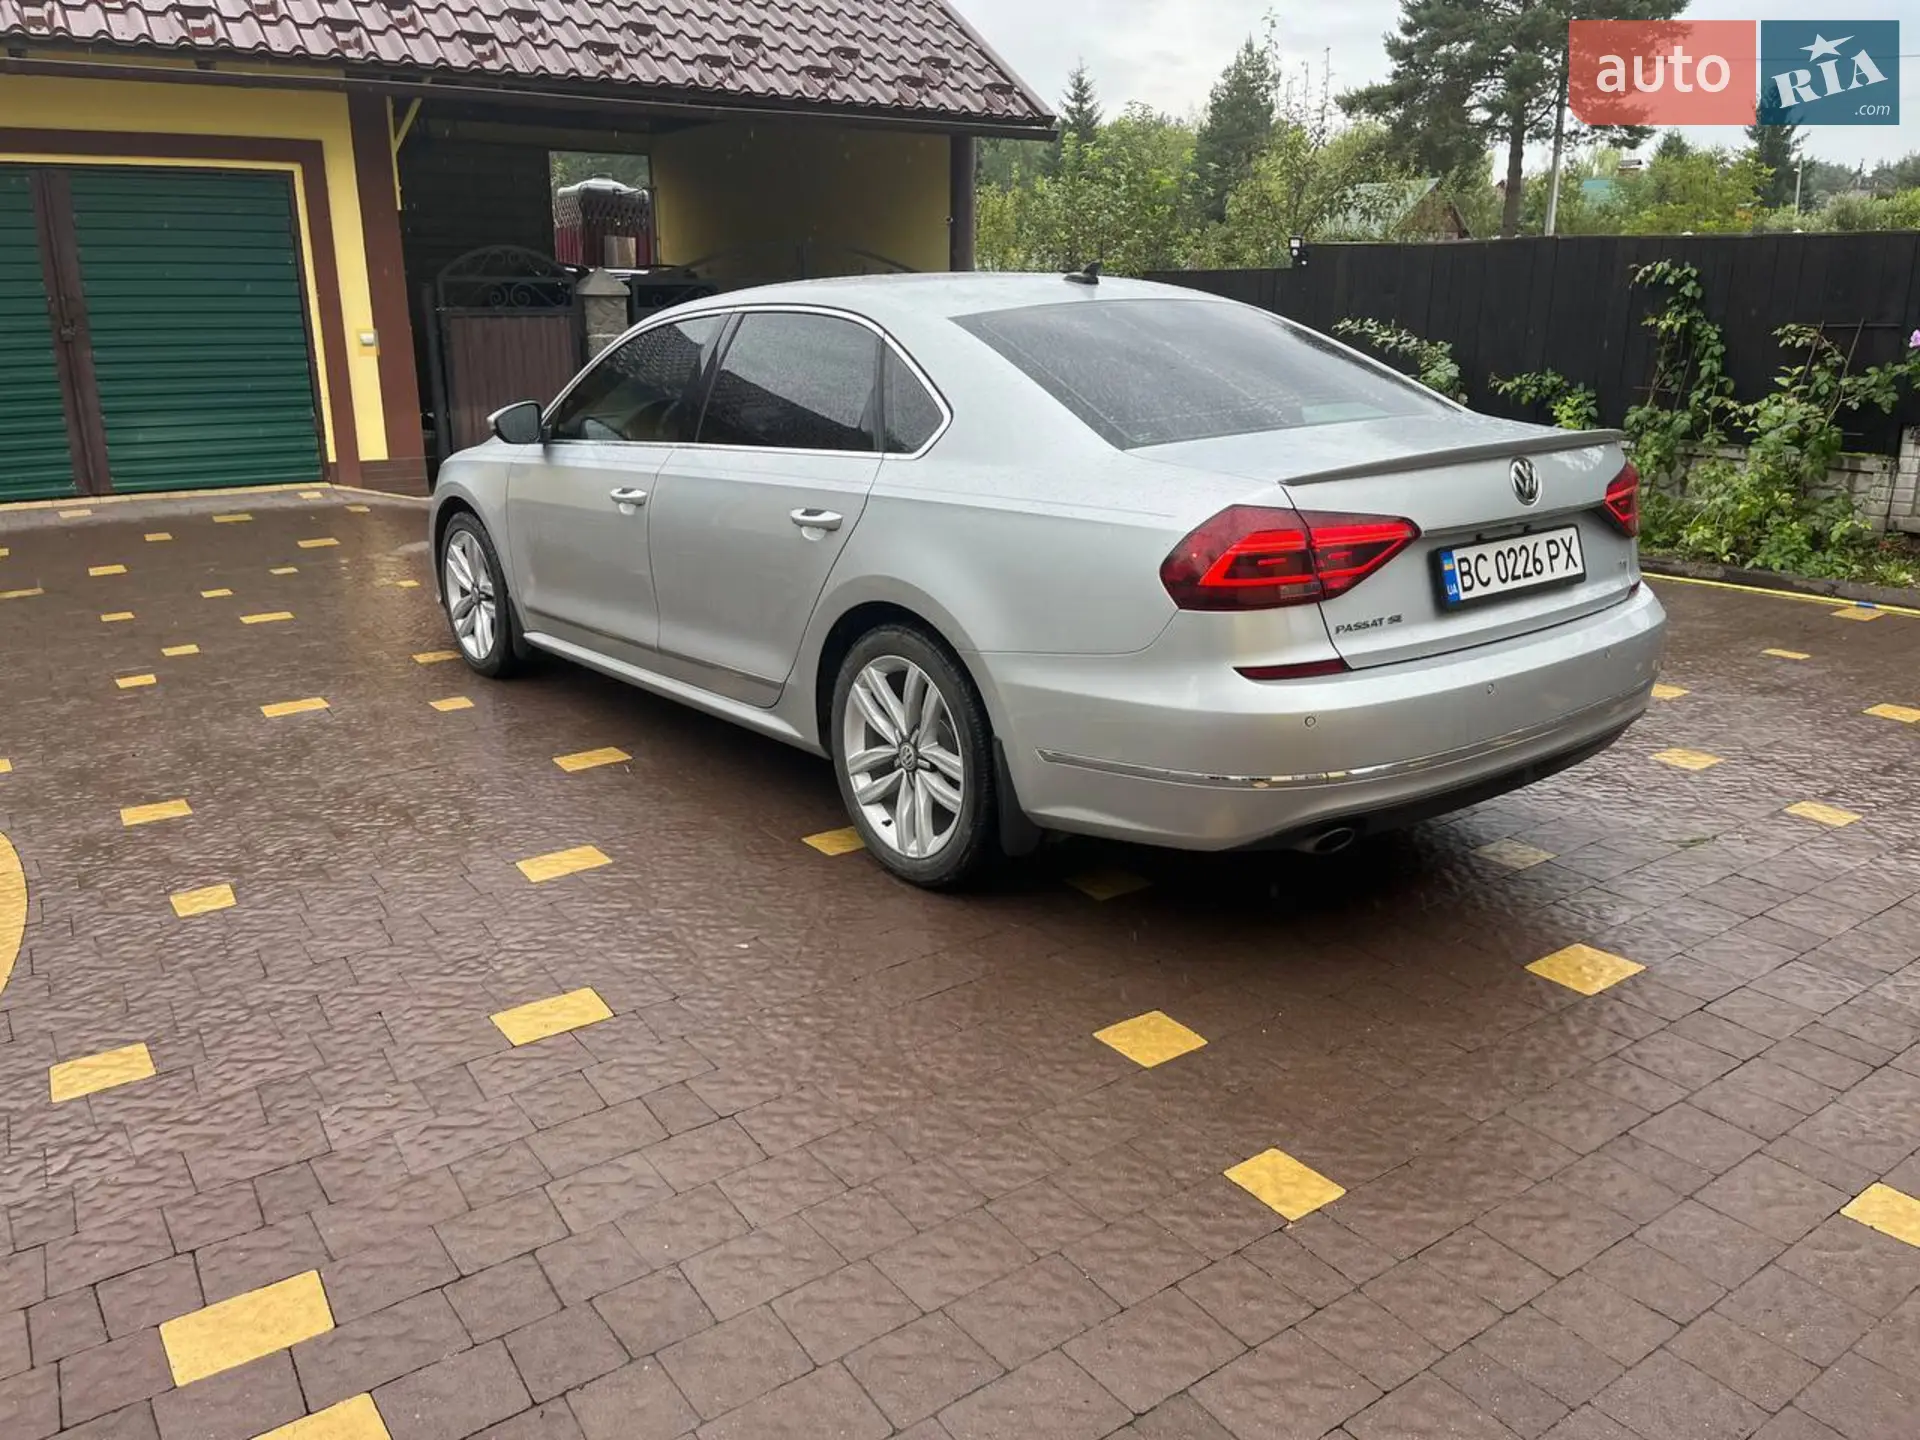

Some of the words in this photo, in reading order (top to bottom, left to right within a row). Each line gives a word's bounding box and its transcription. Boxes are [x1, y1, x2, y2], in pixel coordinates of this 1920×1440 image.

[1457, 553, 1491, 592] BC
[1495, 542, 1544, 584] 0226
[1546, 536, 1578, 573] PX
[1446, 584, 1459, 595] UA
[1335, 617, 1385, 634] PASSAT
